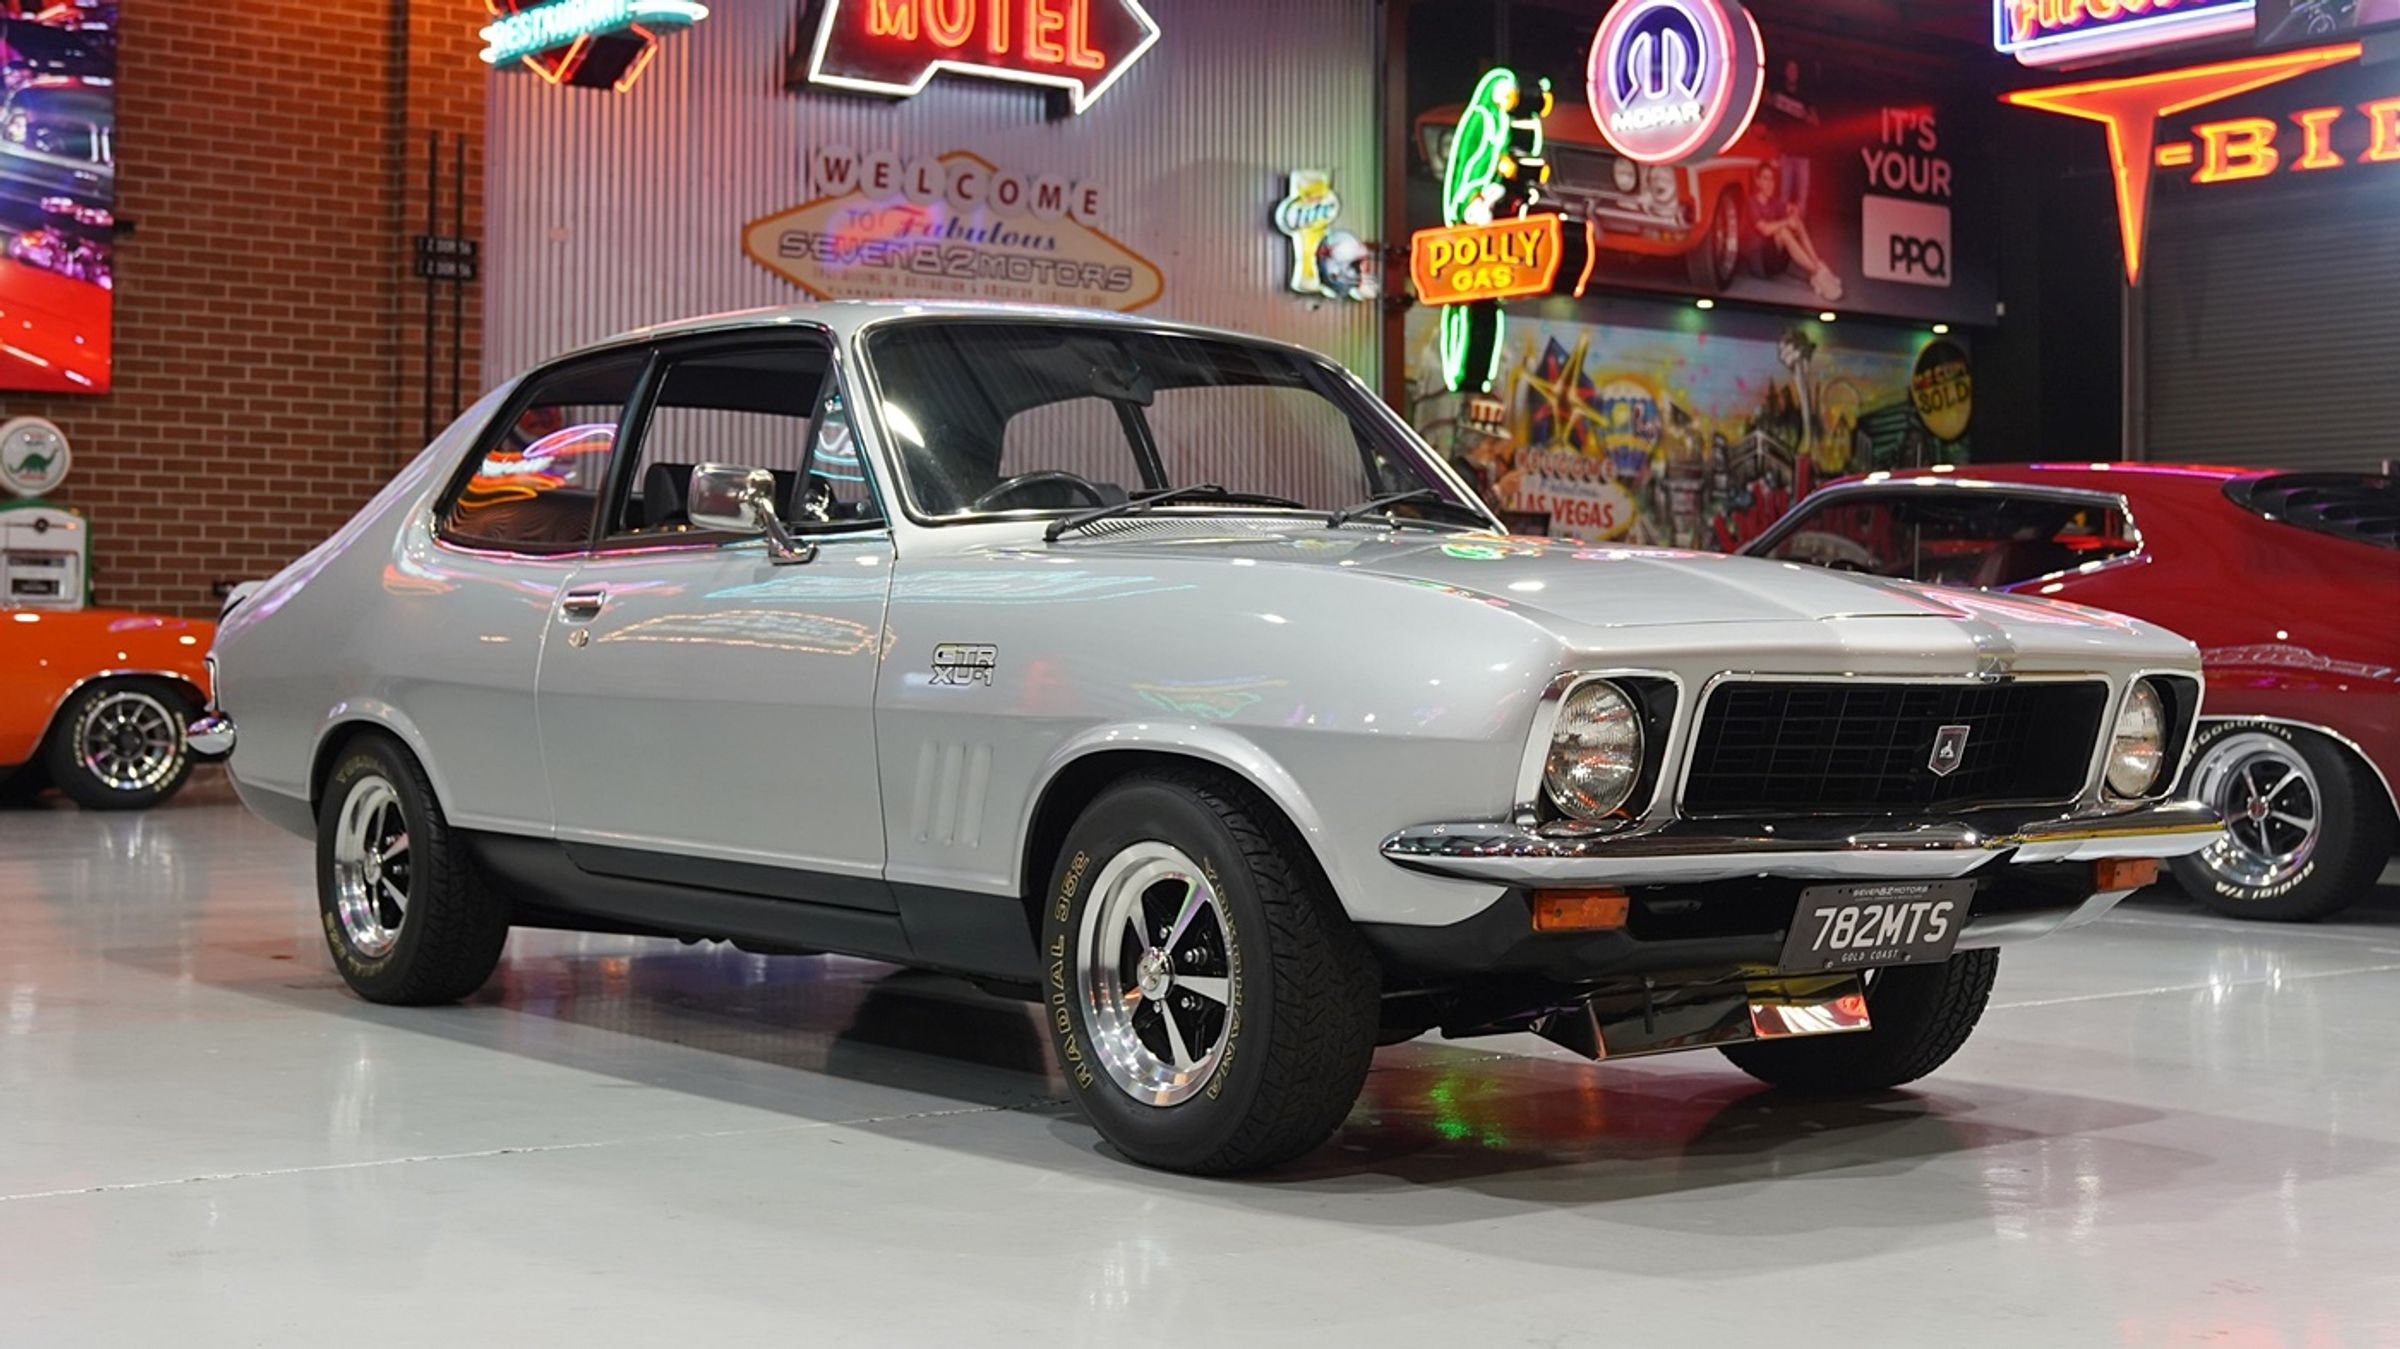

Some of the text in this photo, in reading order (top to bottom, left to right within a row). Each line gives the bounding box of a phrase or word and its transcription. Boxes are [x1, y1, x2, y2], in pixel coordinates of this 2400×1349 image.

[1610, 101, 1706, 132] MOPAR
[1882, 107, 1938, 151] IT'S
[824, 156, 1099, 216] WELCOME
[1861, 147, 1952, 197] YOUR
[882, 205, 1056, 250] Fabulous
[1427, 228, 1544, 277] POLLY
[1890, 233, 1946, 278] PPQ
[1452, 264, 1513, 292] GAS
[1552, 498, 1615, 529] VEGAS
[933, 643, 998, 666] GTR
[1812, 901, 1954, 951] 782MTS
[1841, 949, 1899, 962] GOLD COAST
[1202, 856, 1243, 1101] YOKOHAMA
[1050, 934, 1095, 1090] RADIAL
